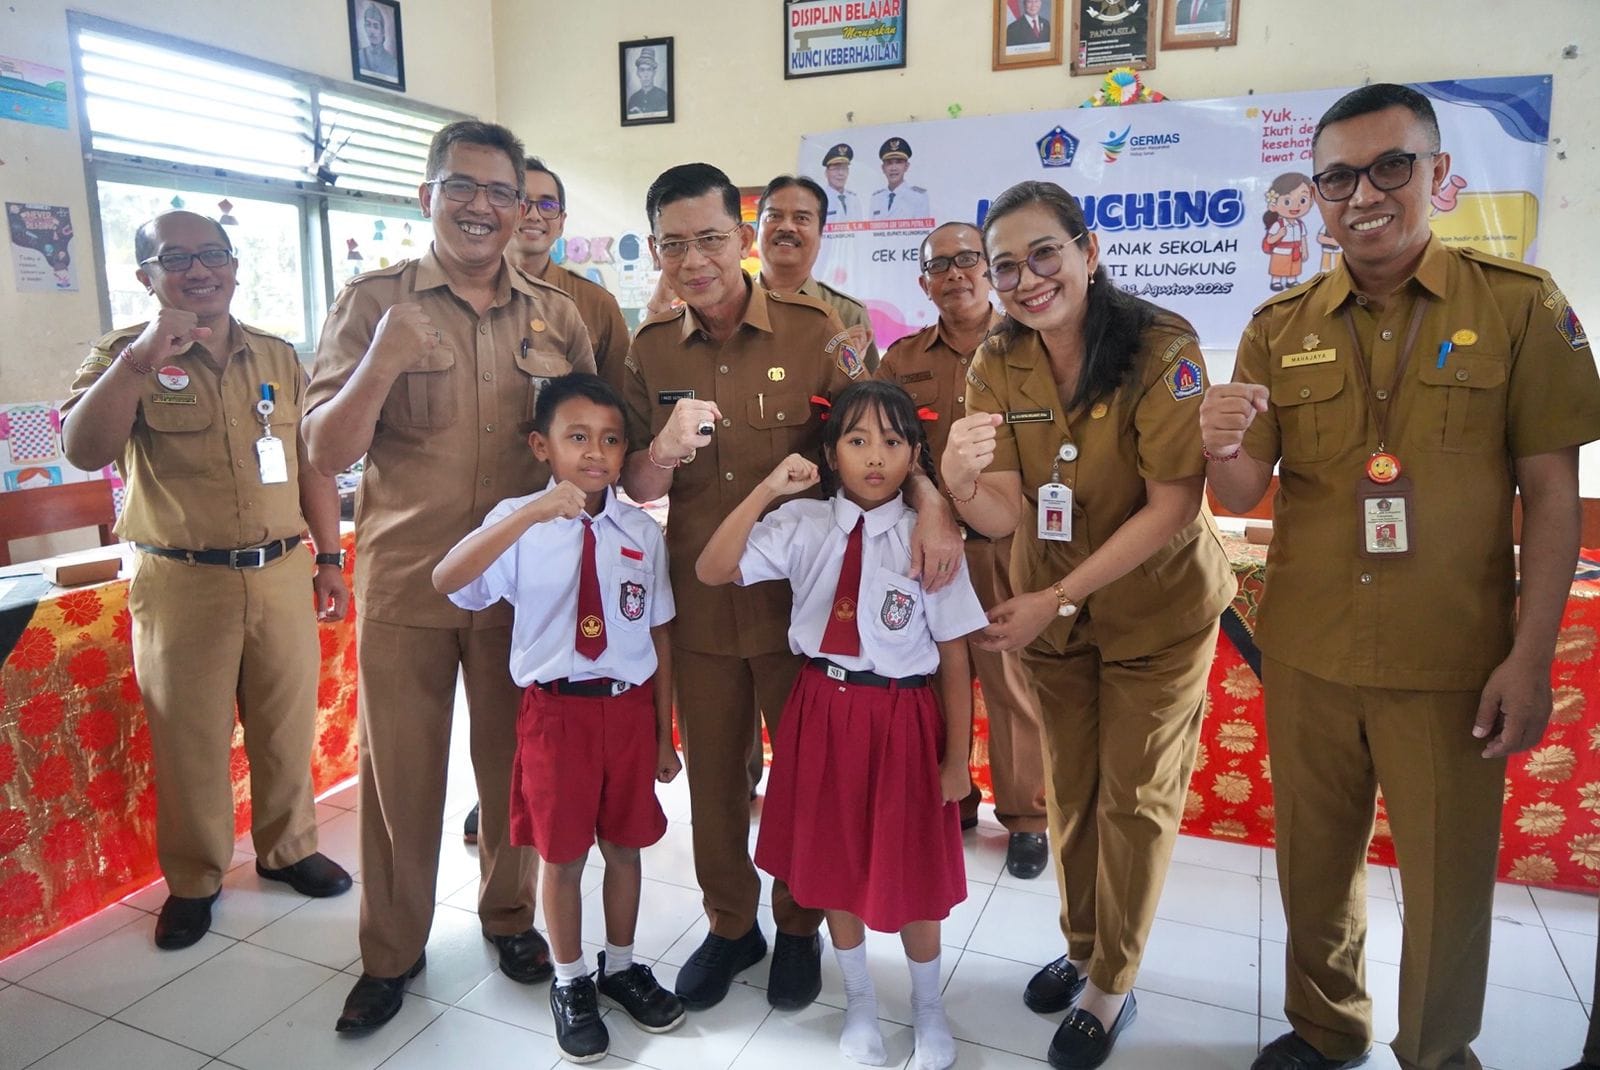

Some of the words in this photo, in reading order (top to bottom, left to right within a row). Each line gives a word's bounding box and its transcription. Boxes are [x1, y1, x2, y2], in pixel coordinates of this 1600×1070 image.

[791, 5, 842, 27] DISIPLIN
[846, 0, 901, 20] BELAJAR
[842, 25, 897, 40] Merupakan
[1089, 26, 1137, 38] PANCASILA
[791, 49, 822, 69] KUNCI
[824, 43, 899, 66] KEBERHASILAN
[1262, 108, 1312, 123] Yuk...
[1263, 125, 1293, 137] Ikuti
[1299, 124, 1314, 134] de
[1130, 133, 1180, 146] GERMAS
[1262, 138, 1312, 150] kesehat
[1262, 152, 1295, 163] lewat
[1106, 242, 1152, 255] ANAK
[1159, 239, 1238, 255] SEKOLAH
[872, 249, 897, 262] CEK
[902, 248, 920, 261] KE
[1109, 264, 1128, 276] TI
[1135, 261, 1237, 277] KLUNGKUNG
[1140, 283, 1194, 297] Agustus
[1195, 283, 1234, 295] 2025
[1291, 353, 1326, 362] MAHAJAYA
